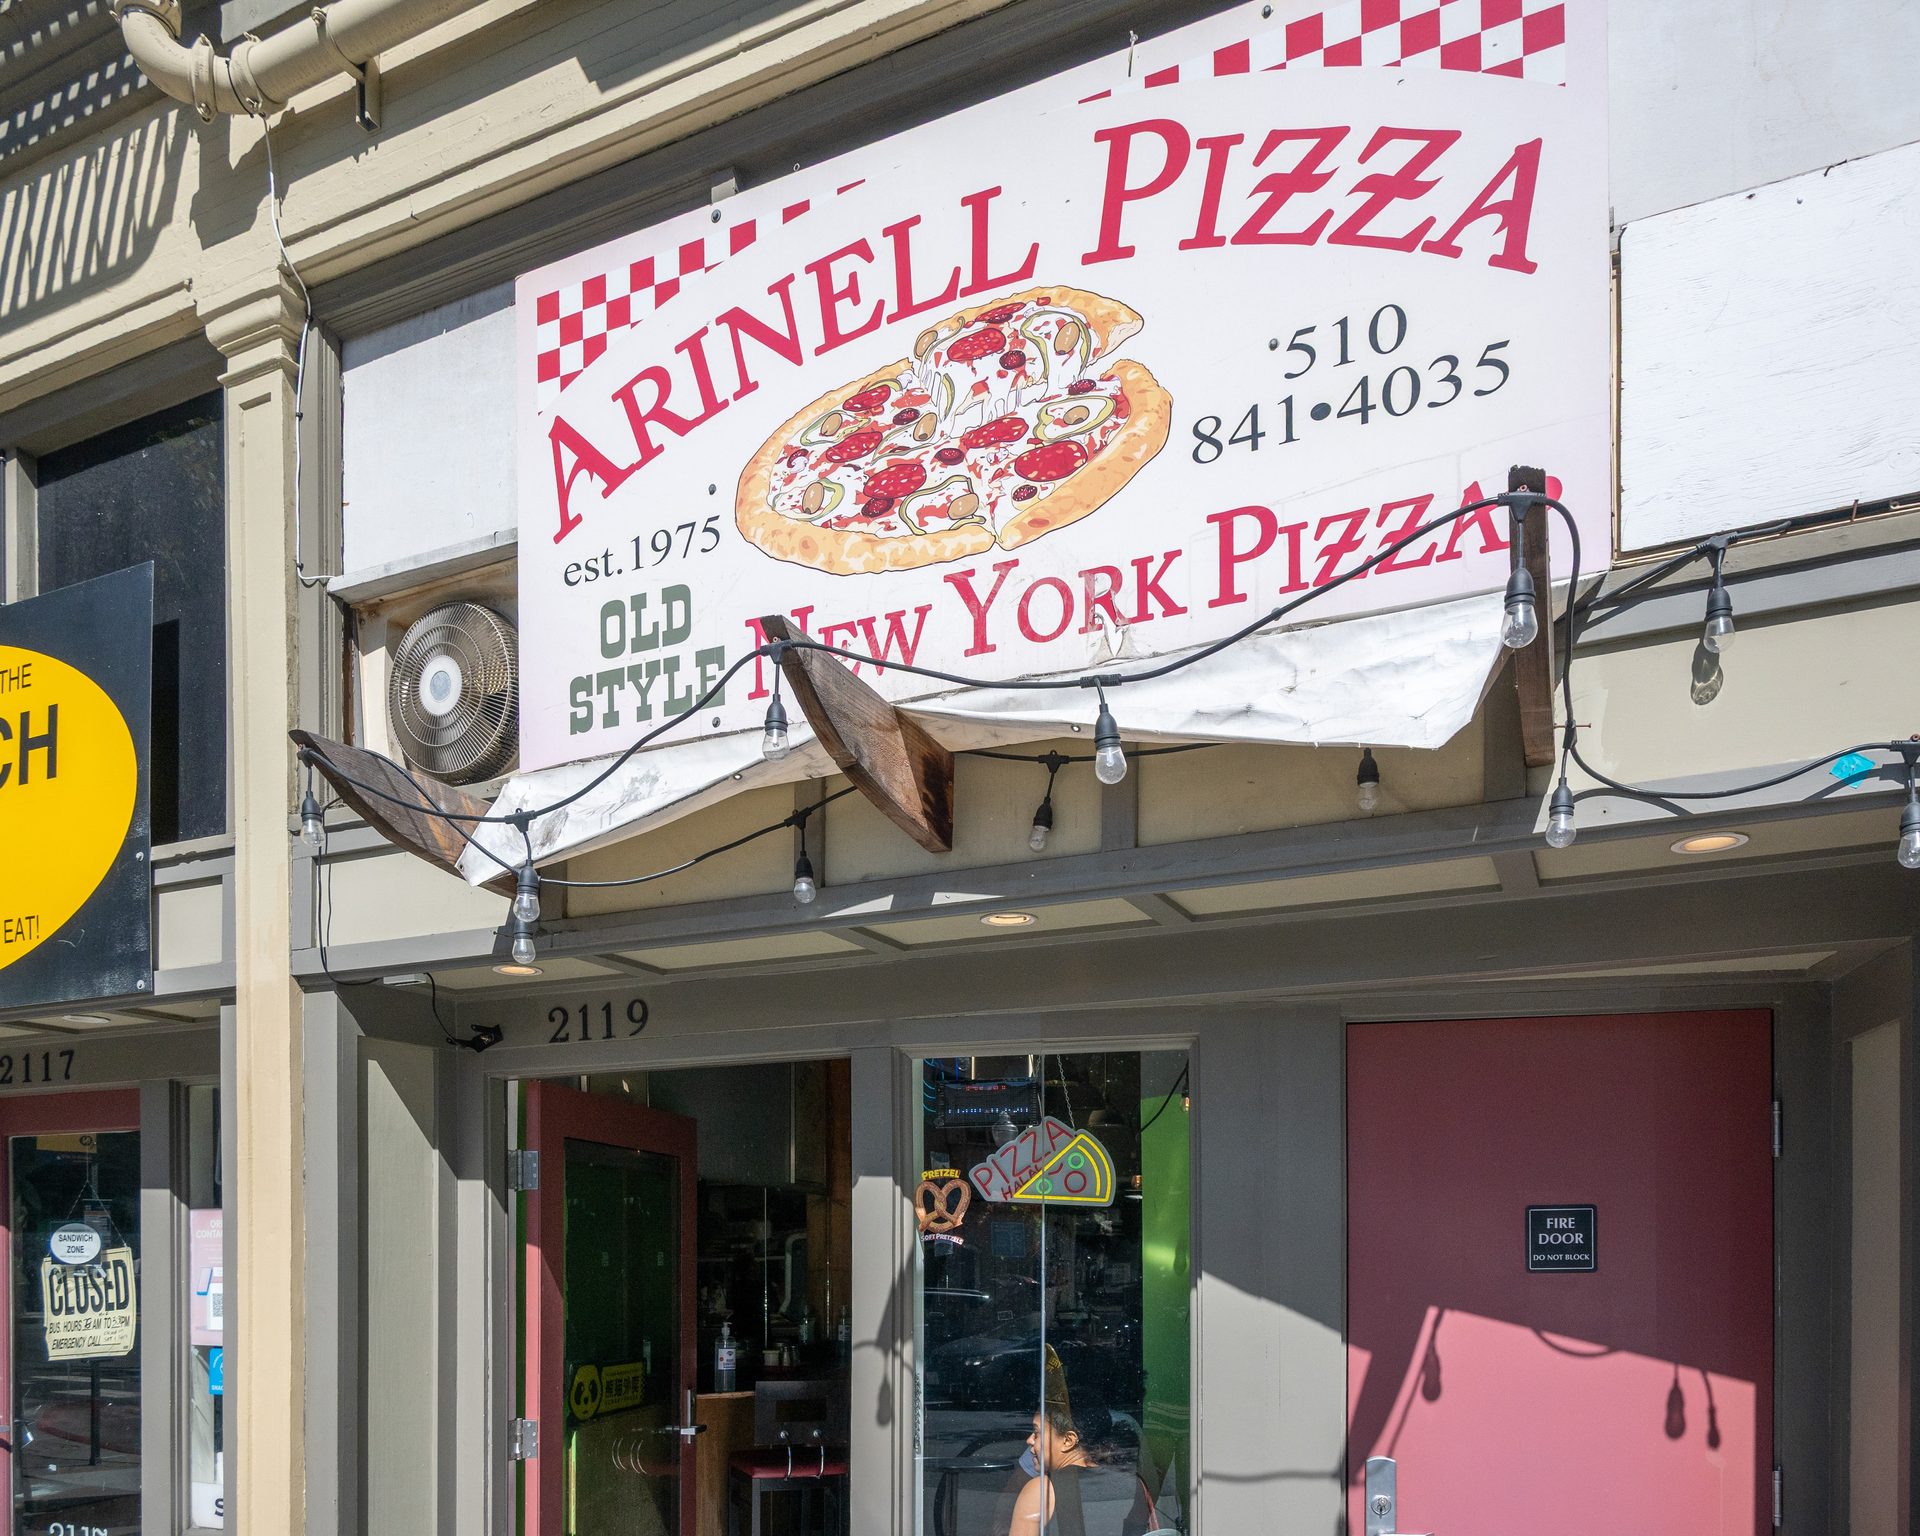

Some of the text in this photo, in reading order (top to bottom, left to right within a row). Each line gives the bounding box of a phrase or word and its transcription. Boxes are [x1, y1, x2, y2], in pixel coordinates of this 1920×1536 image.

[549, 118, 1543, 545] ARINELL PIZZA
[1284, 304, 1407, 379] 510
[599, 583, 692, 659] OLD
[944, 548, 1188, 658] YORK
[569, 645, 726, 735] STYLE
[3, 914, 40, 945] EAT!
[547, 998, 649, 1043] 2119
[0, 1048, 74, 1085] 2117
[921, 1168, 961, 1181] PRETZEL
[973, 1119, 1074, 1198] PIZZA
[58, 1234, 93, 1242] SANDWICH
[1538, 1232, 1585, 1245] DOOR
[1546, 1217, 1576, 1229] FIRE
[66, 1245, 85, 1254] ZONE
[48, 1259, 131, 1317] CLOSED
[51, 1336, 87, 1350] EMERGENCY
[87, 1335, 101, 1347] CALL
[63, 1319, 82, 1333] HOURS
[92, 1317, 102, 1330] AM
[103, 1316, 112, 1329] TO
